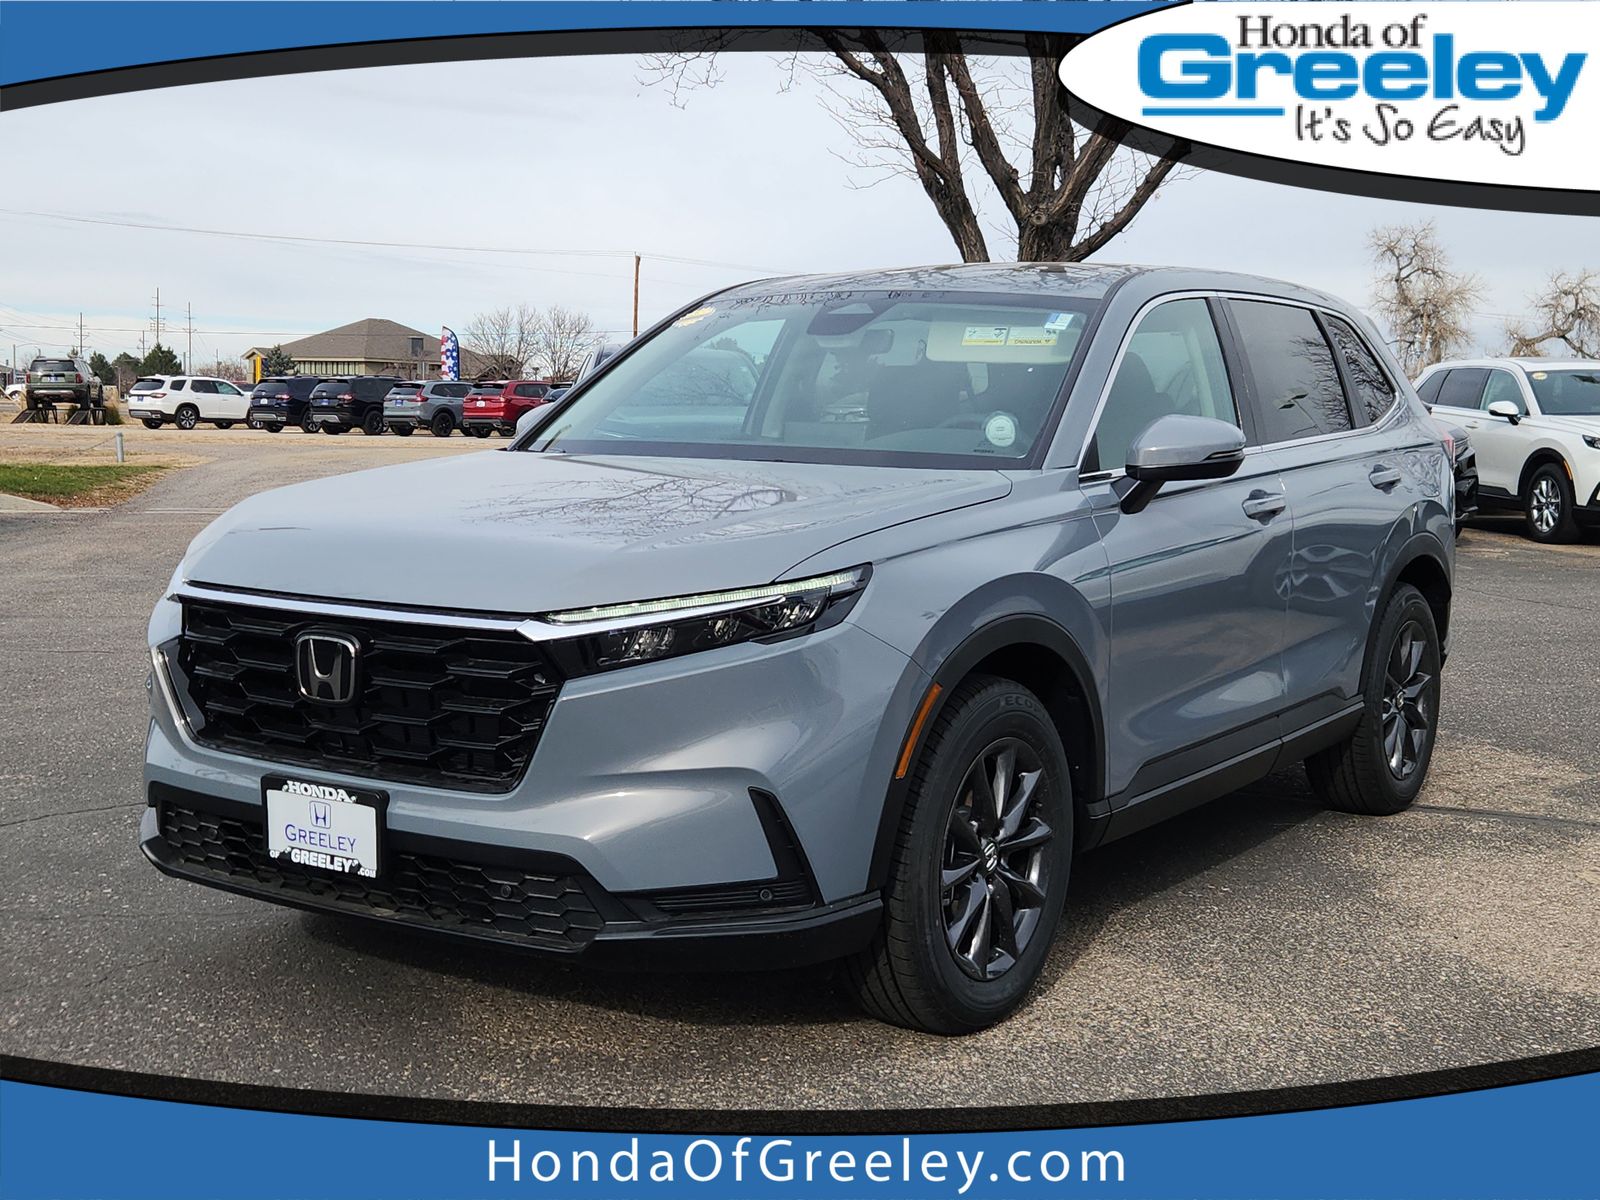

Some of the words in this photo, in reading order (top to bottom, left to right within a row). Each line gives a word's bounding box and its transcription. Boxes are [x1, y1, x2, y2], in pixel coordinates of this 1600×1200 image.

[286, 780, 353, 803] HONDA
[284, 823, 357, 853] GREELEY
[269, 850, 280, 859] OF
[290, 848, 353, 873] GREELEY
